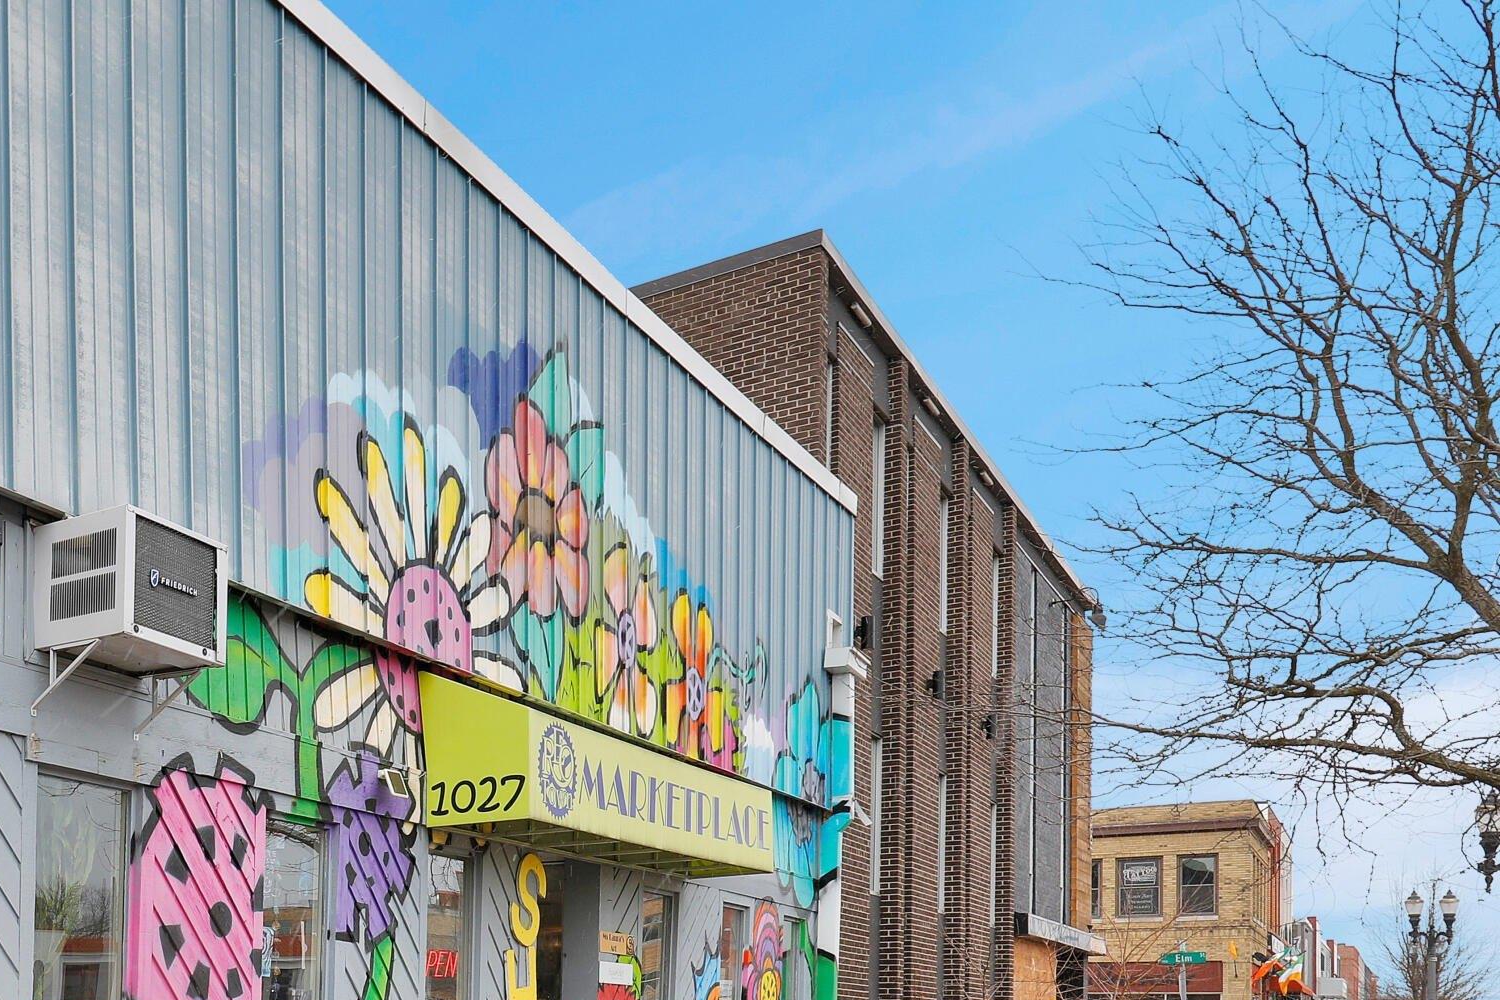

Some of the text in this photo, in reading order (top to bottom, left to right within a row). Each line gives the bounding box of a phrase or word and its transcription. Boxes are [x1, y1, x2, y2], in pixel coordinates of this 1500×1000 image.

[160, 576, 198, 597] FRIEDRICH
[430, 774, 526, 818] 1027
[578, 753, 770, 851] MARKETPLACE
[425, 950, 458, 978] PEN
[1175, 953, 1193, 963] Elm
